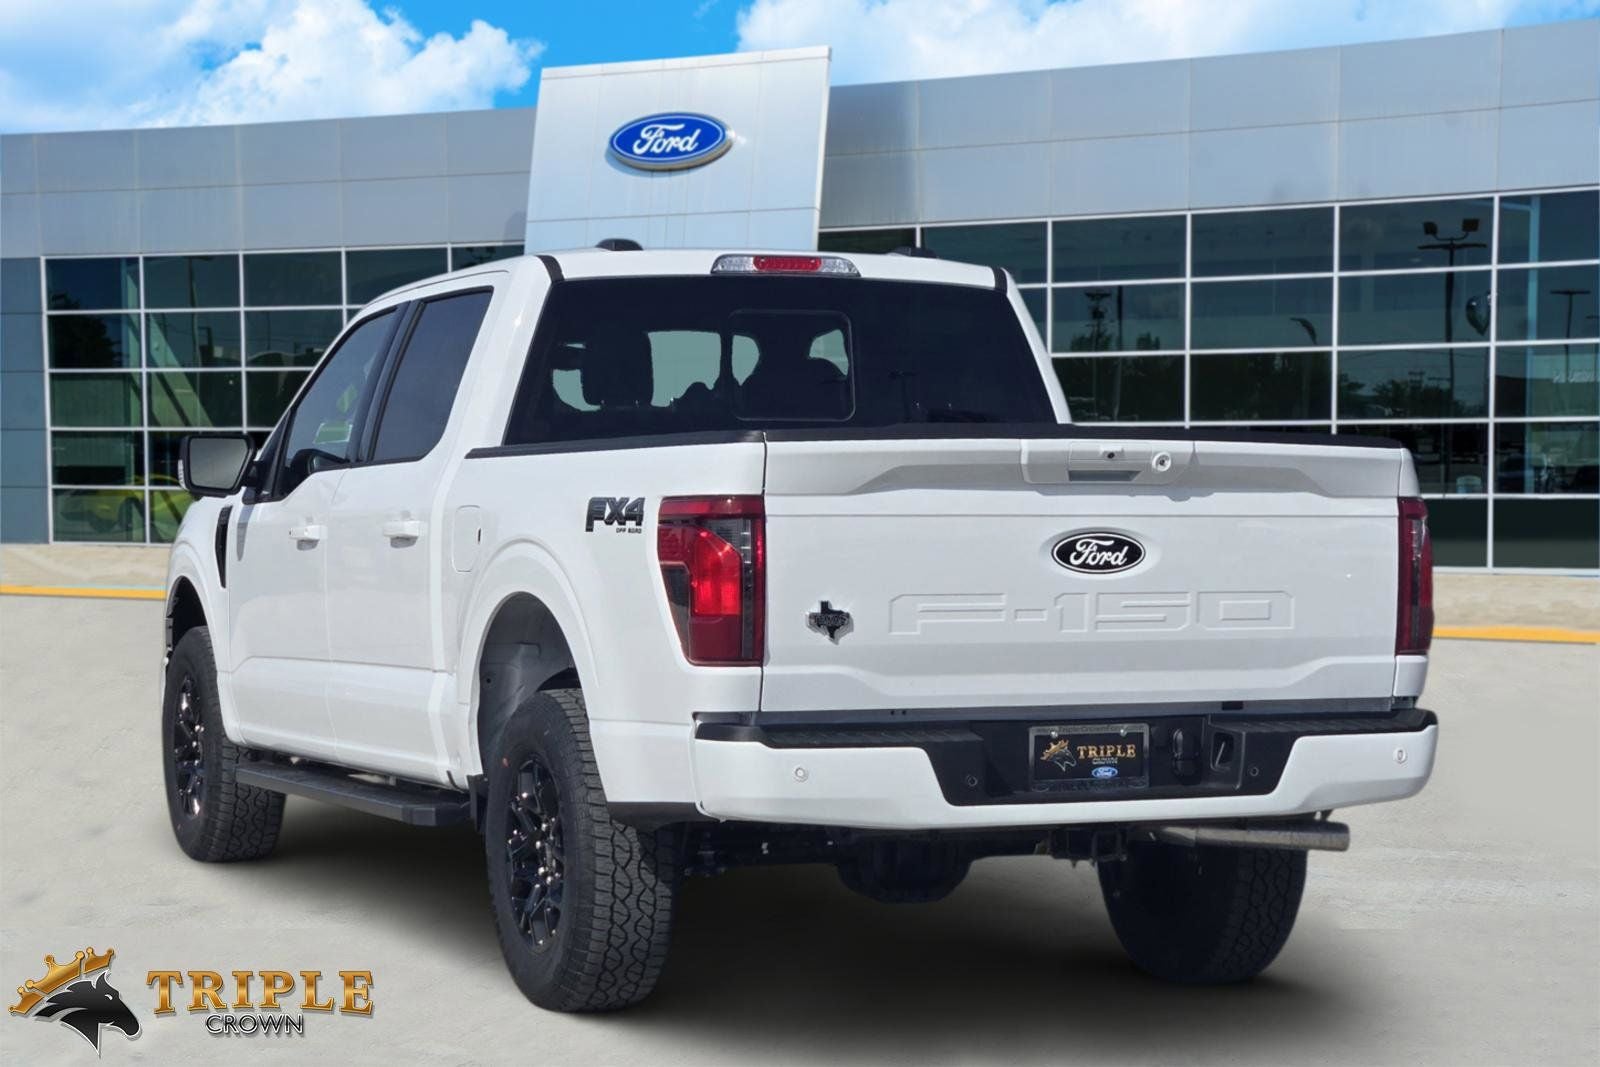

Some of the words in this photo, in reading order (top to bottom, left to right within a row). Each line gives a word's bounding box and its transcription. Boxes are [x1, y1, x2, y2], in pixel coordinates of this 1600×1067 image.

[633, 124, 702, 155] Ford
[585, 497, 646, 532] FX4
[1070, 539, 1129, 565] Ford
[889, 591, 1295, 635] F-150
[1077, 744, 1136, 759] TRIPLE
